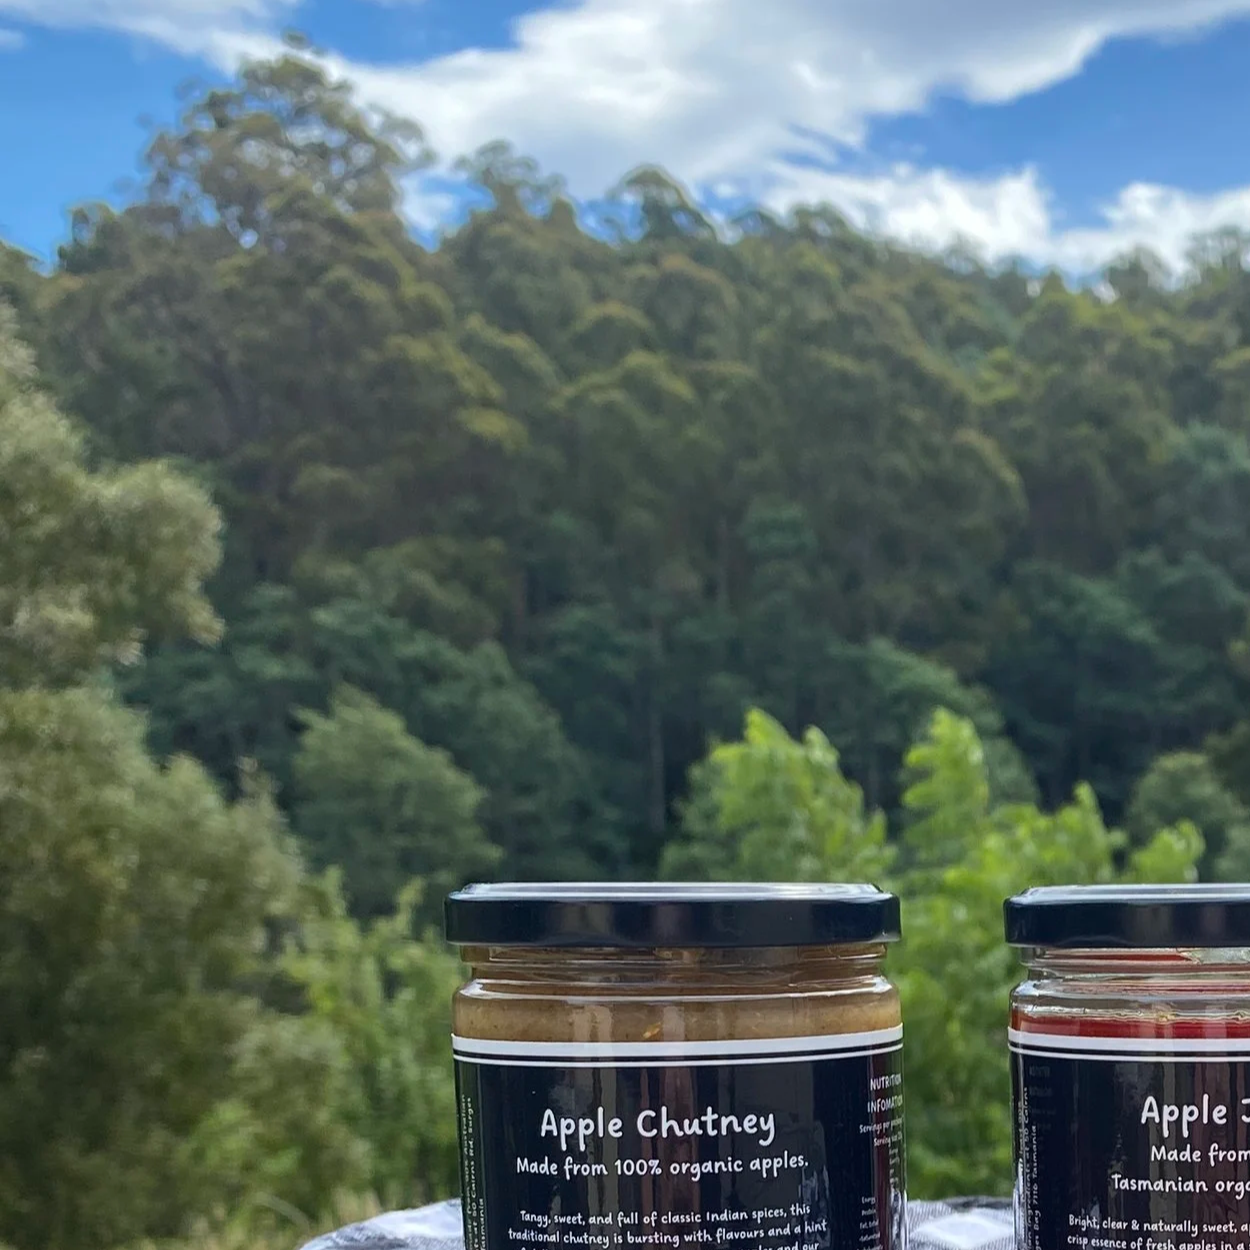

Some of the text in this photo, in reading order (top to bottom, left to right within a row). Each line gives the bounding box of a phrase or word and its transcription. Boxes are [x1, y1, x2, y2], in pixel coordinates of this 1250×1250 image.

[1141, 1093, 1227, 1138] Apple
[541, 1106, 775, 1152] Apple Chutney
[1151, 1143, 1201, 1163] Made
[516, 1150, 809, 1182] Made from 100% organic apples.
[1111, 1173, 1208, 1193] Tasmanian
[520, 1203, 811, 1228] Tangy, sweet, and full of classic Indian spices, this
[1068, 1213, 1100, 1231] Bright,
[1102, 1216, 1128, 1231] clear
[1131, 1219, 1140, 1231] &
[1143, 1219, 1199, 1238] naturally
[1202, 1221, 1237, 1233] sweet,
[508, 1219, 828, 1249] traditional chutney is bursting with flavours and a hint
[1067, 1235, 1089, 1250] crisp
[1091, 1238, 1127, 1249] essence
